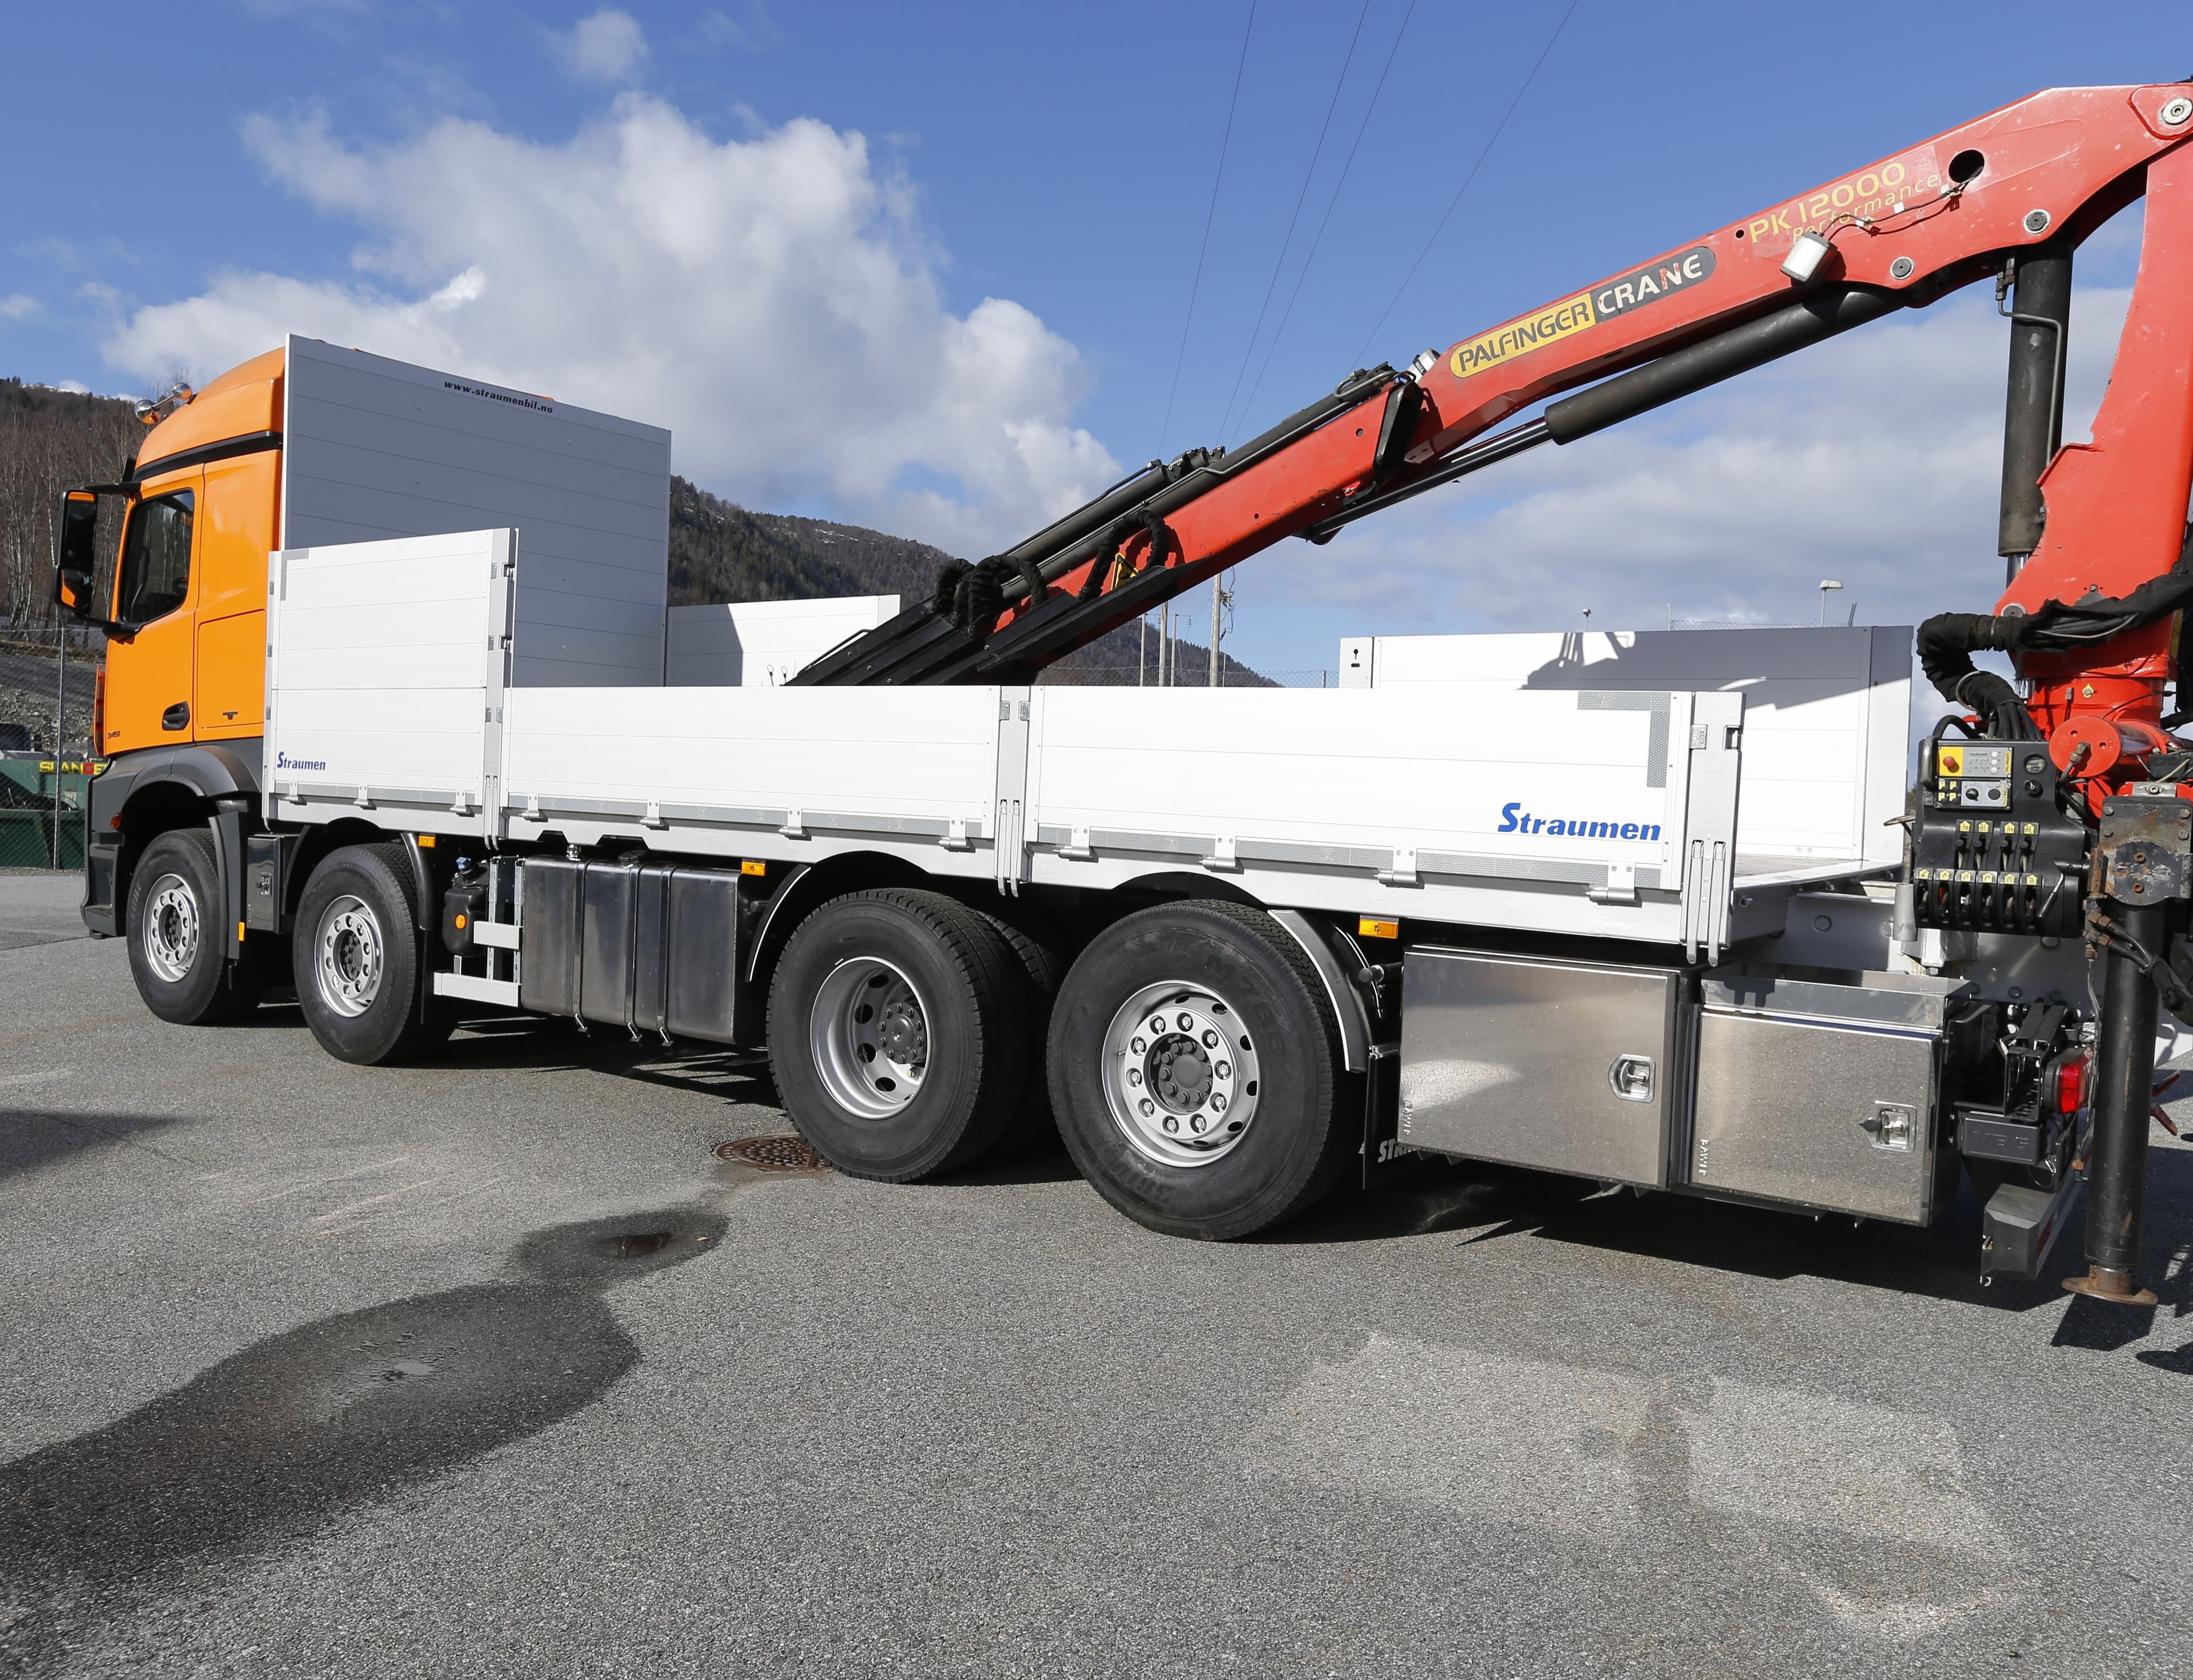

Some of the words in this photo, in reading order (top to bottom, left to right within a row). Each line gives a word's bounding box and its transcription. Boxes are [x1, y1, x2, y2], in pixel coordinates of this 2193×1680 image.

[1749, 208, 1792, 244] PK
[1798, 162, 1905, 223] 12000
[1459, 301, 1590, 372] PALFINGER
[1597, 254, 1703, 315] CRANE
[444, 381, 553, 413] www.straumenbil.no
[277, 751, 326, 771] Straumen
[1497, 802, 1661, 841] Straumen
